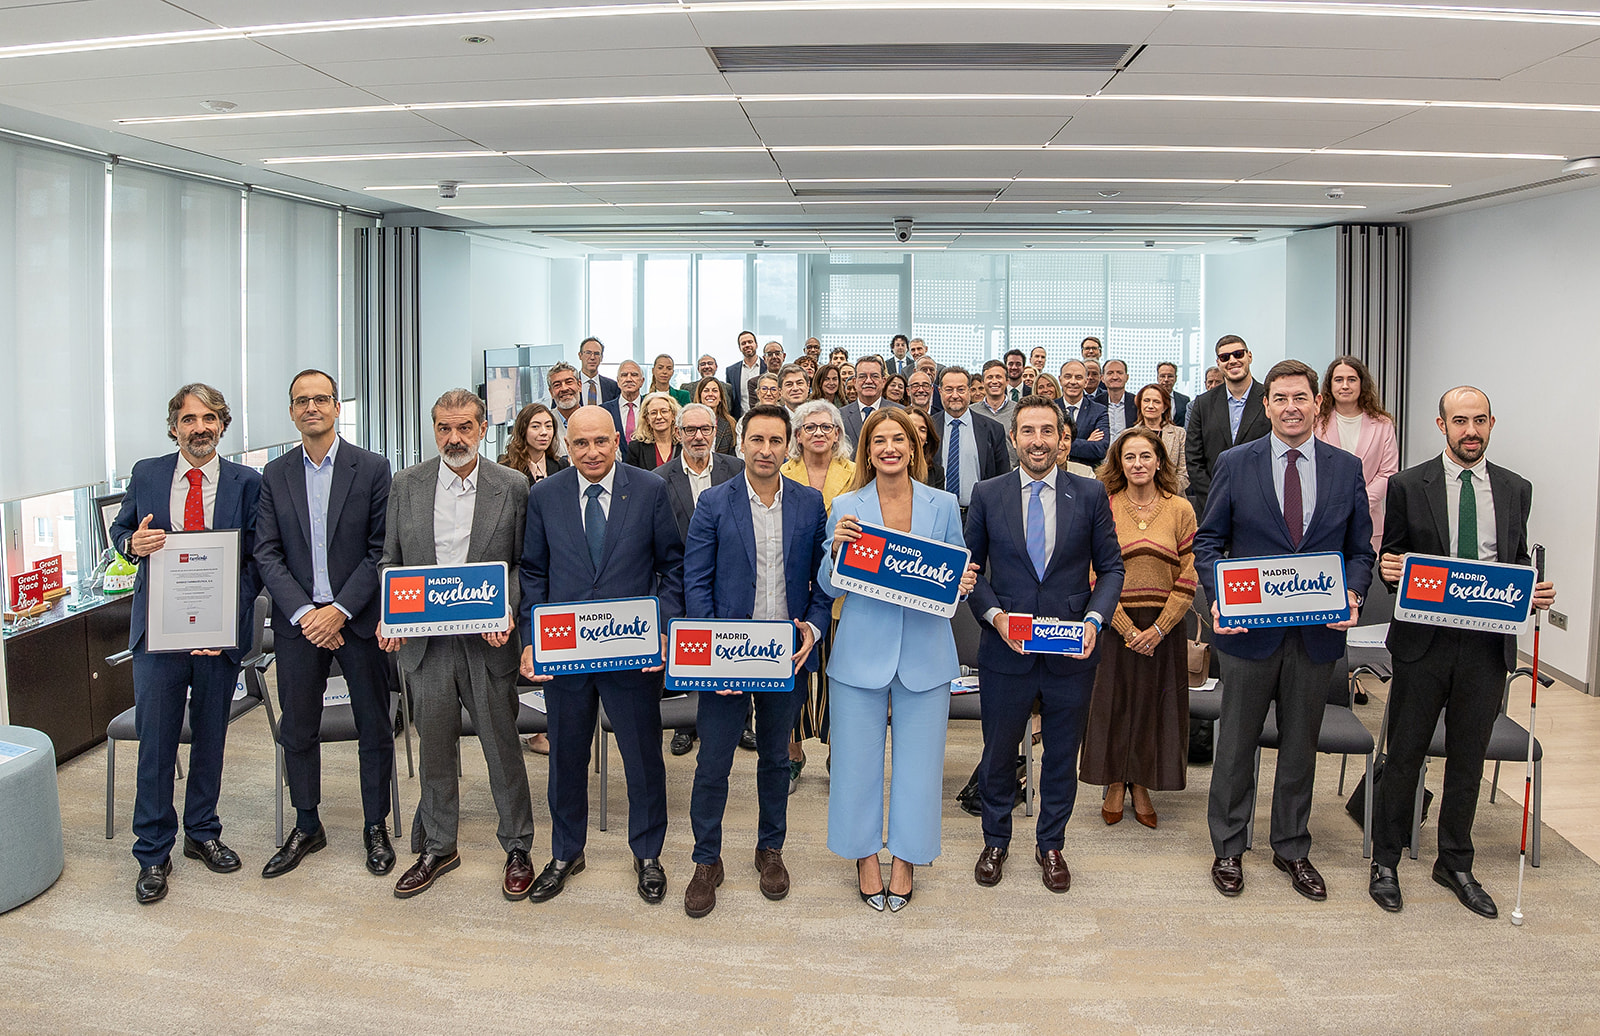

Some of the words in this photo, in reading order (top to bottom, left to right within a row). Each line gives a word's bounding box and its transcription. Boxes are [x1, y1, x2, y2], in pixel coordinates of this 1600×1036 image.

[888, 542, 922, 558] MADRID
[39, 558, 59, 569] Great
[884, 554, 955, 583] excelente
[17, 573, 39, 585] Great
[1262, 568, 1297, 577] MADRID
[1451, 571, 1487, 582] MADRID
[18, 581, 39, 592] Place
[428, 577, 462, 586] MADRID
[1264, 571, 1336, 596] excelente
[428, 580, 499, 605] excelente
[840, 578, 881, 595] EMPRESA
[885, 591, 946, 613] CERTIFICADA
[1448, 580, 1524, 603] excelente
[579, 613, 613, 622] MADRID
[1228, 617, 1272, 626] EMPRESA
[1276, 613, 1341, 623] CERTIFICADA
[1404, 612, 1448, 623] EMPRESA
[1452, 618, 1517, 631] CERTIFICADA
[390, 626, 432, 634] EMPRESA
[437, 622, 500, 632] CERTIFICADA
[580, 615, 651, 641] excelente
[1034, 624, 1084, 638] excelente
[715, 632, 749, 640] MADRID
[715, 638, 786, 660] excelente
[542, 663, 586, 672] EMPRESA
[590, 657, 653, 669] CERTIFICADA
[723, 680, 786, 688] CERTIFICADA
